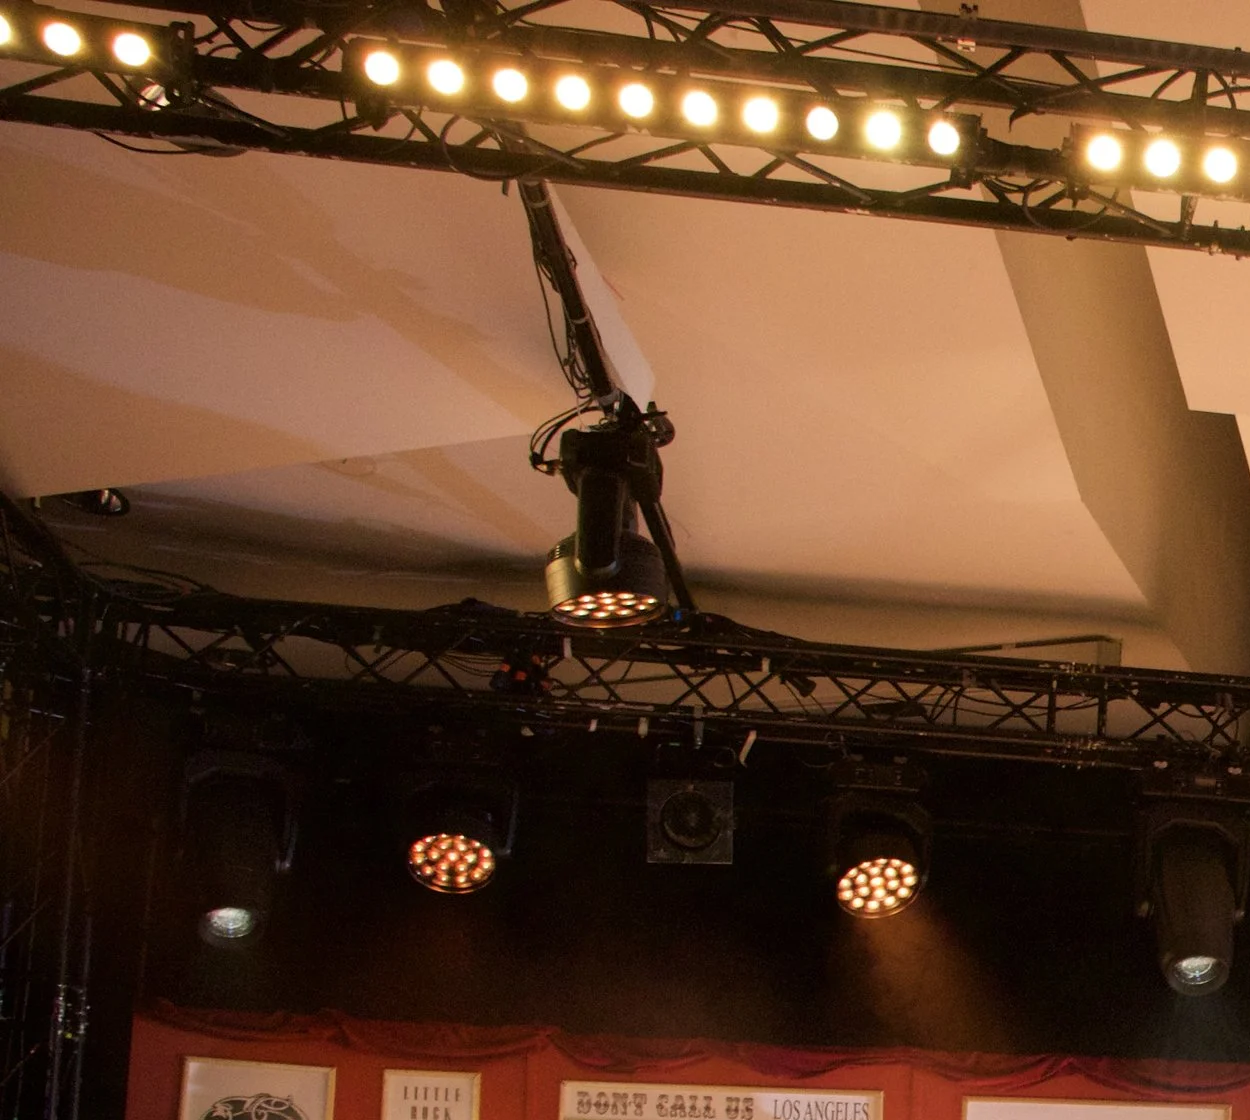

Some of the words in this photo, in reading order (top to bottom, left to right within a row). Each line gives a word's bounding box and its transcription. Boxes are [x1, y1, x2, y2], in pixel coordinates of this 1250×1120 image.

[403, 1085, 462, 1102] LITTLE
[410, 1106, 452, 1120] ROCK
[577, 1091, 647, 1116] DON'T
[656, 1094, 716, 1119] CALL
[726, 1096, 755, 1120] US
[773, 1099, 800, 1120] LOS
